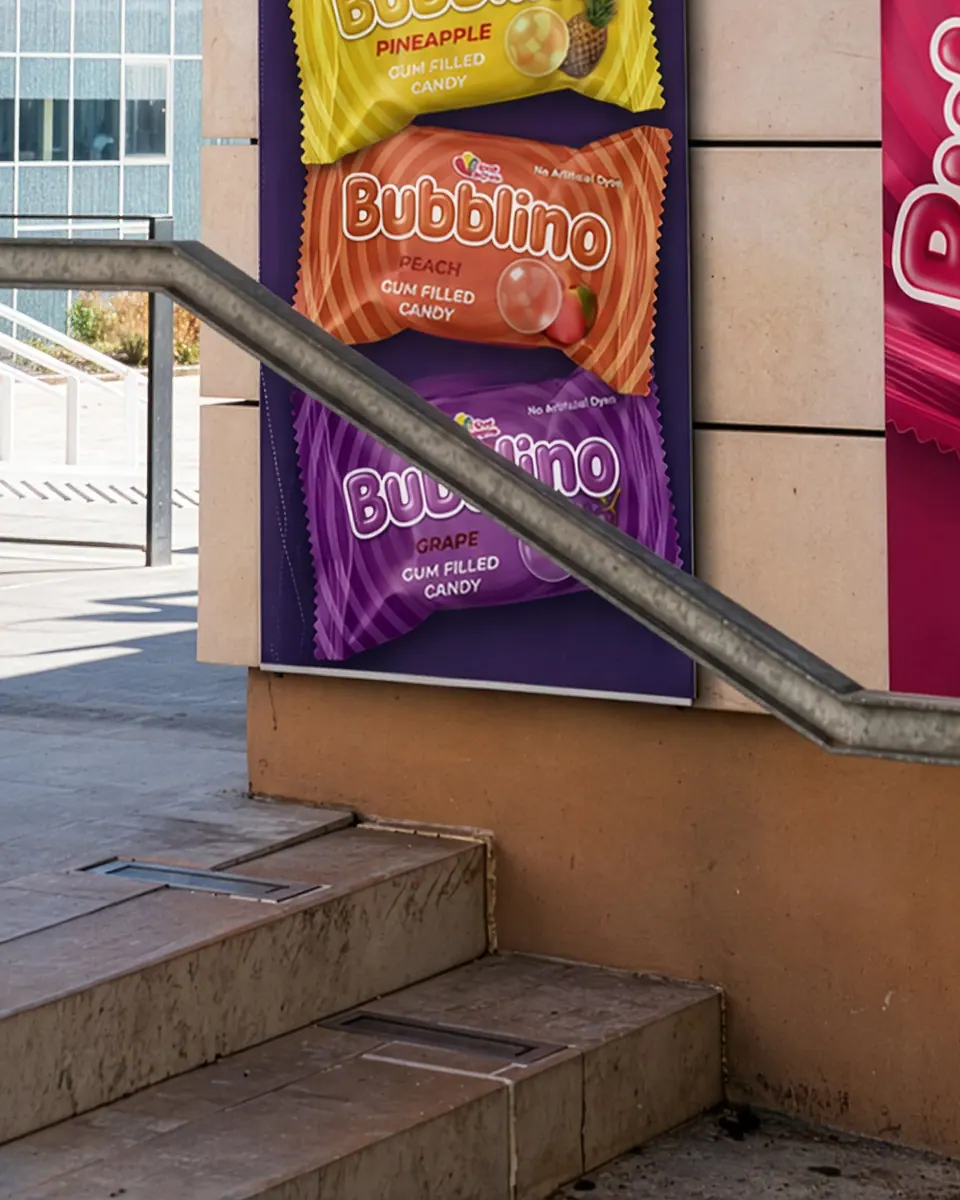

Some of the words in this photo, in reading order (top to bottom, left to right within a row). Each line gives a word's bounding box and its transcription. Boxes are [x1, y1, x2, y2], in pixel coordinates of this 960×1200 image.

[376, 23, 492, 57] PINEAPPLE
[388, 60, 425, 81] GUM
[428, 51, 485, 73] FILLED
[410, 73, 468, 96] CANDY
[533, 166, 549, 177] No
[342, 172, 612, 272] Bubblino
[399, 255, 461, 278] PEACH
[380, 279, 417, 298] GUM
[420, 284, 475, 305] FILLED
[399, 301, 456, 322] CANDY
[527, 406, 543, 416] No
[415, 531, 479, 554] GRAPE
[401, 561, 440, 582] GUM
[444, 555, 500, 577] FILLED
[424, 578, 482, 599] CANDY
